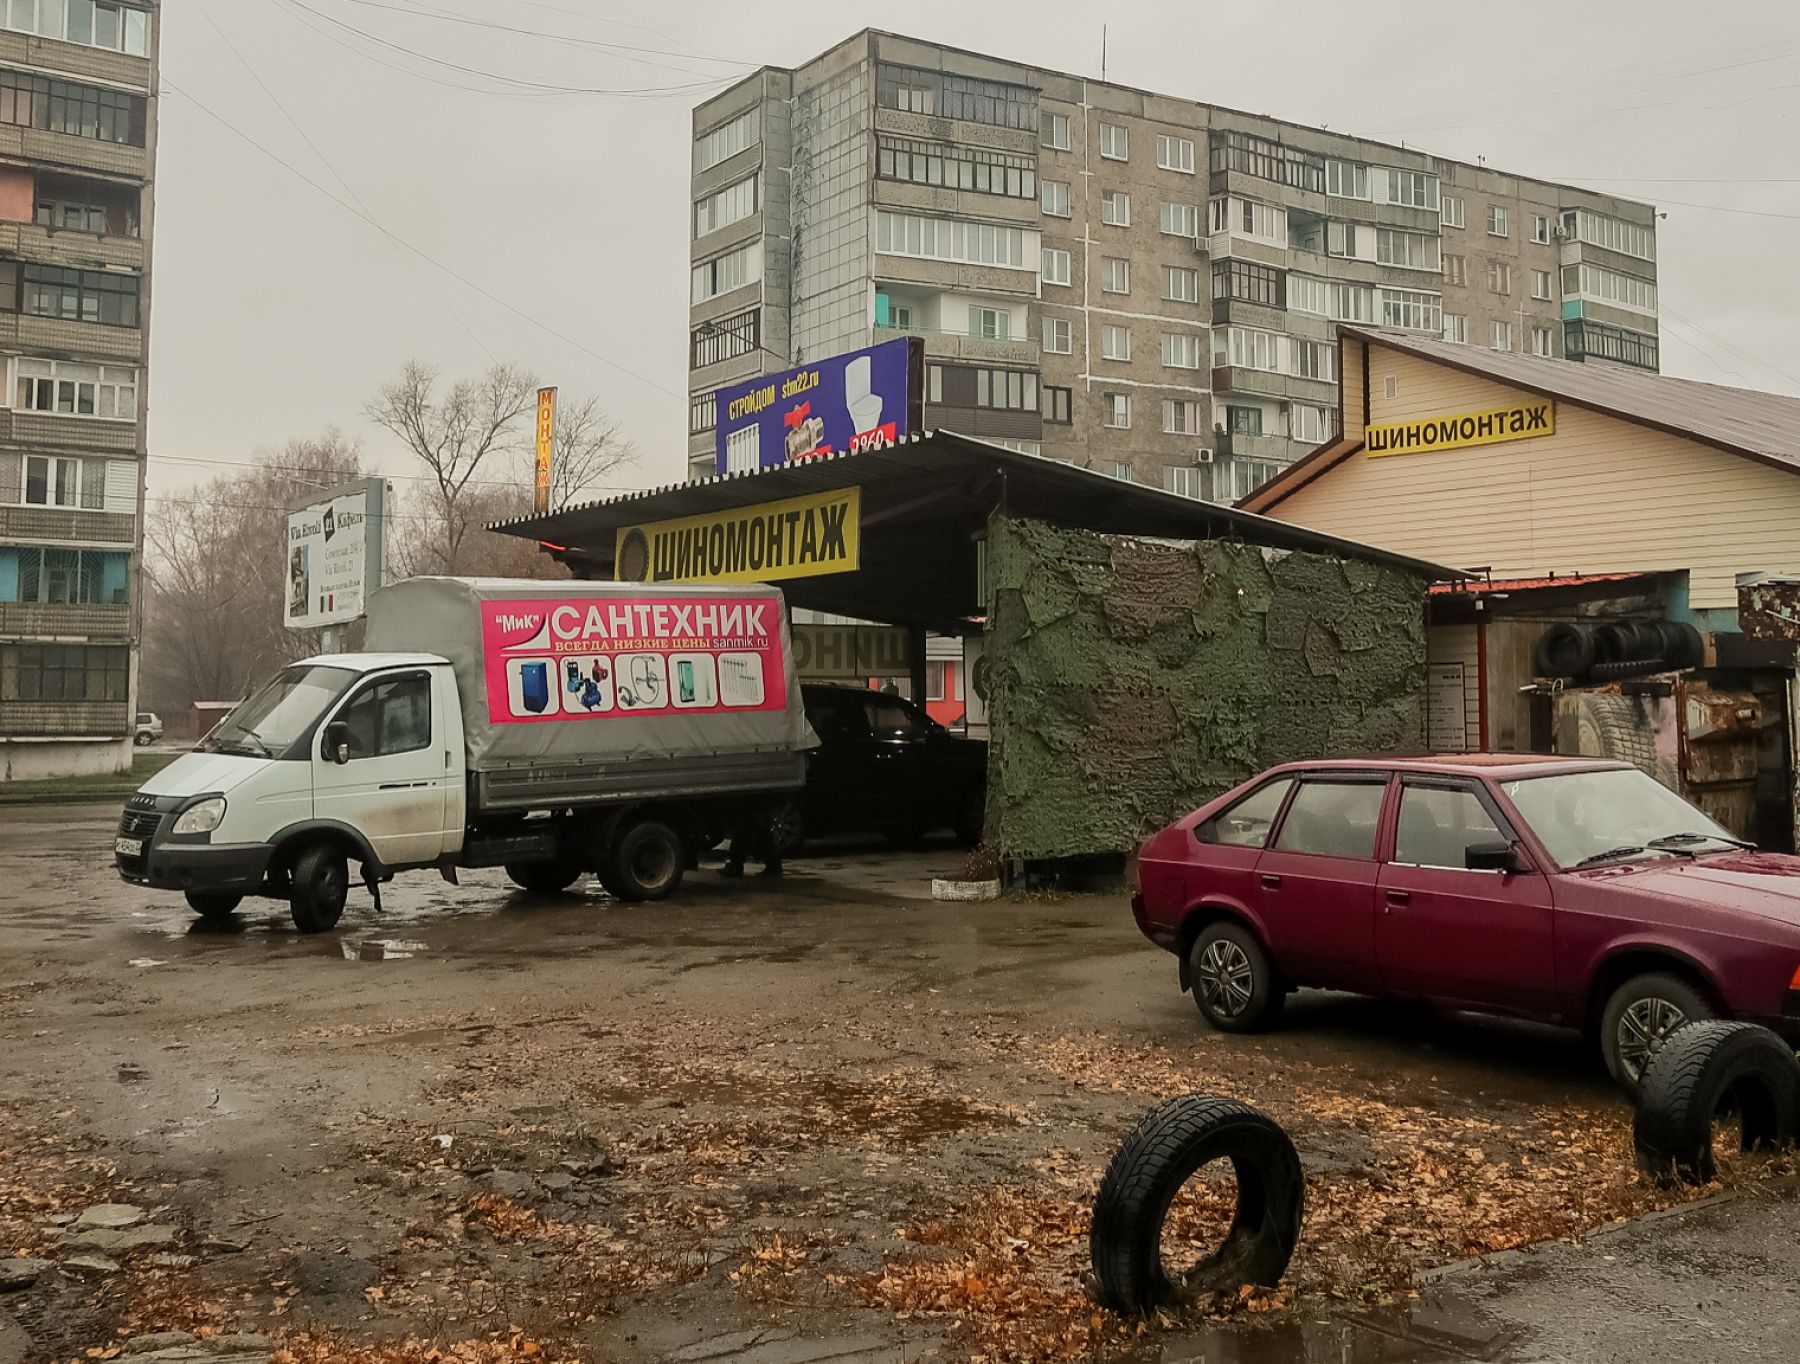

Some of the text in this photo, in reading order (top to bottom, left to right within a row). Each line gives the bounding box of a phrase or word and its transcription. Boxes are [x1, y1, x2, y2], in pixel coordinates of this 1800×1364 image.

[728, 369, 820, 421] СТРОЙДОМ stm22.ru
[653, 502, 849, 581] ШИНОМОНТАЖ
[551, 604, 768, 640] САНТЕХНИК
[555, 634, 769, 652] ВСЕГДА НИЗКИЕ ЦЕНЫ sanmik.ru
